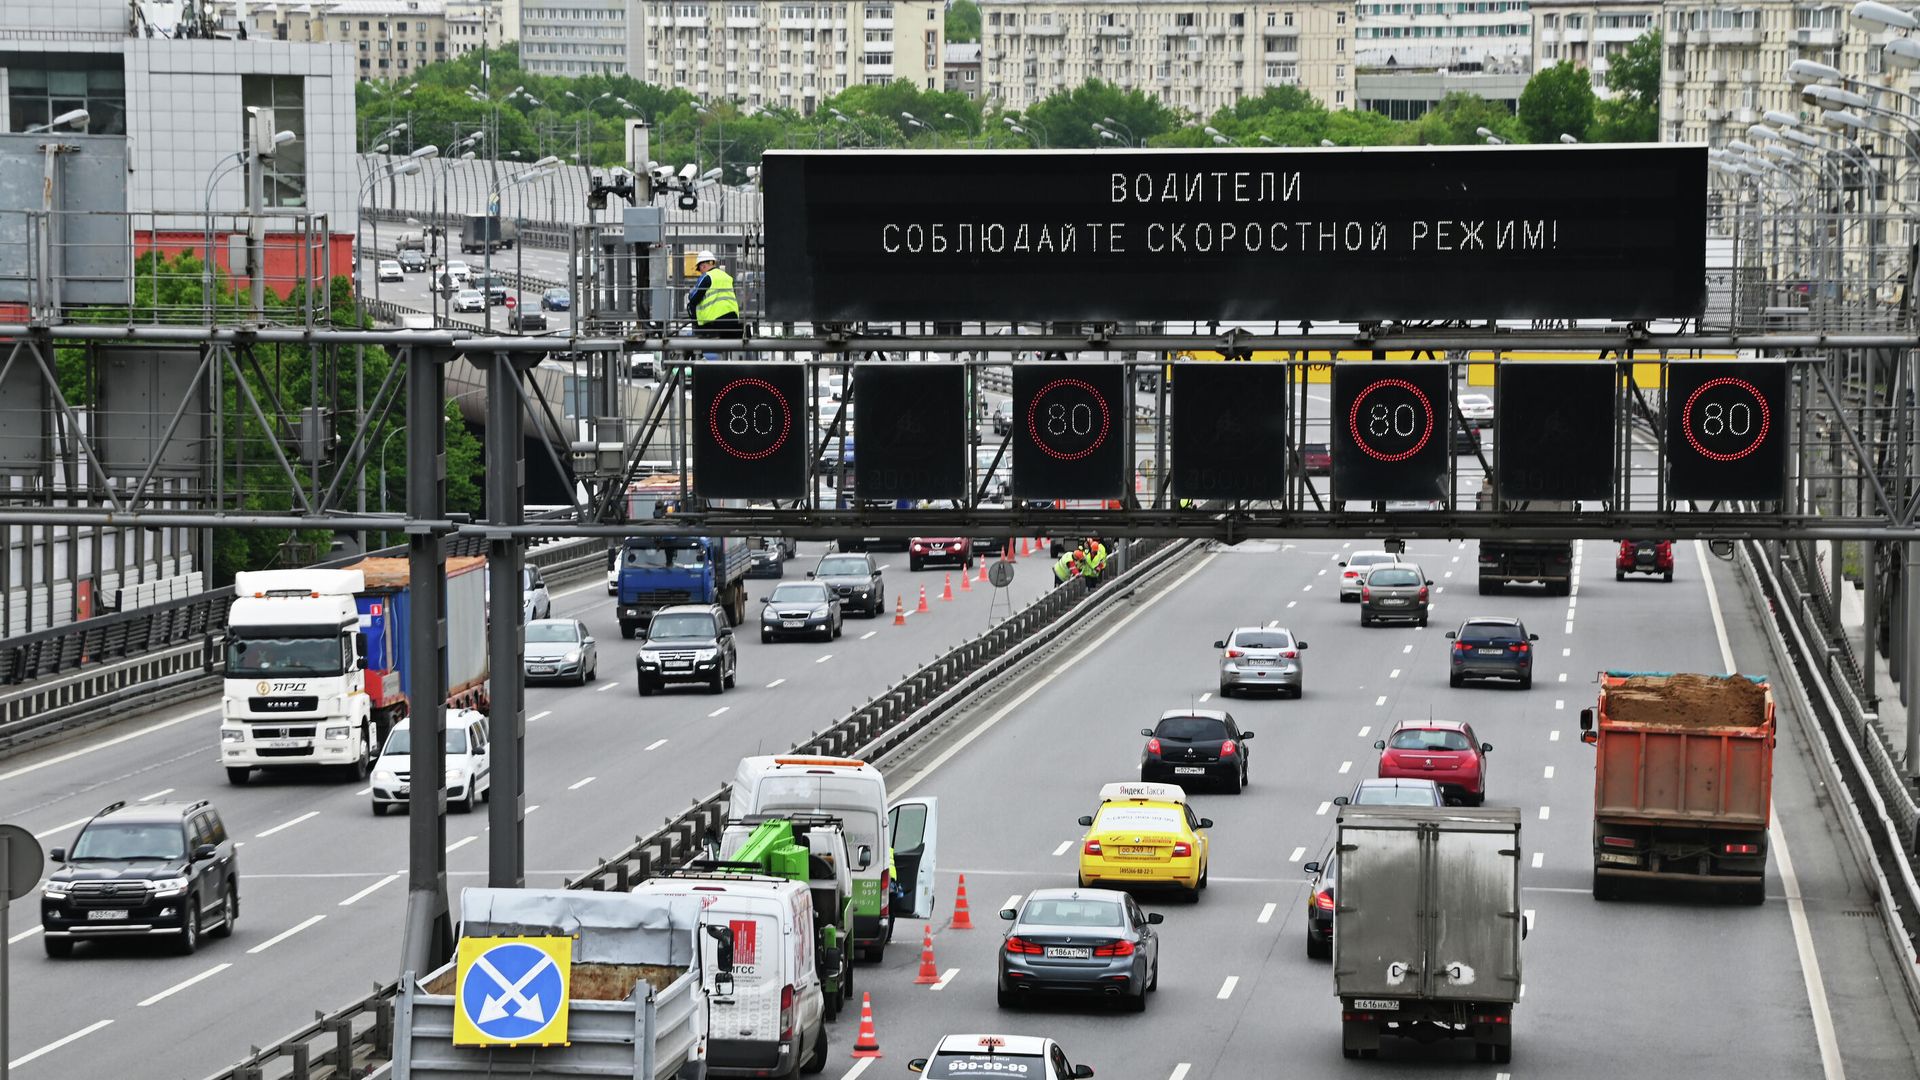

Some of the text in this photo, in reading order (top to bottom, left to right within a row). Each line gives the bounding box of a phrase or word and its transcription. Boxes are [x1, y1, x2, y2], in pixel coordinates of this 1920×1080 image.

[1111, 171, 1301, 203] ВОДИТЕЛИ
[883, 219, 1557, 253] СОБЛЮДАЙТЕ СКОРОСТНОЙ РЕЖИМ!
[729, 403, 773, 435] 80
[1047, 403, 1092, 436] 80
[1369, 403, 1415, 437] 80
[1703, 402, 1751, 436] 80
[273, 683, 306, 692] ЯРД
[1120, 785, 1165, 795] Яндекс Такси
[948, 1061, 1028, 1073] 999-99-99
